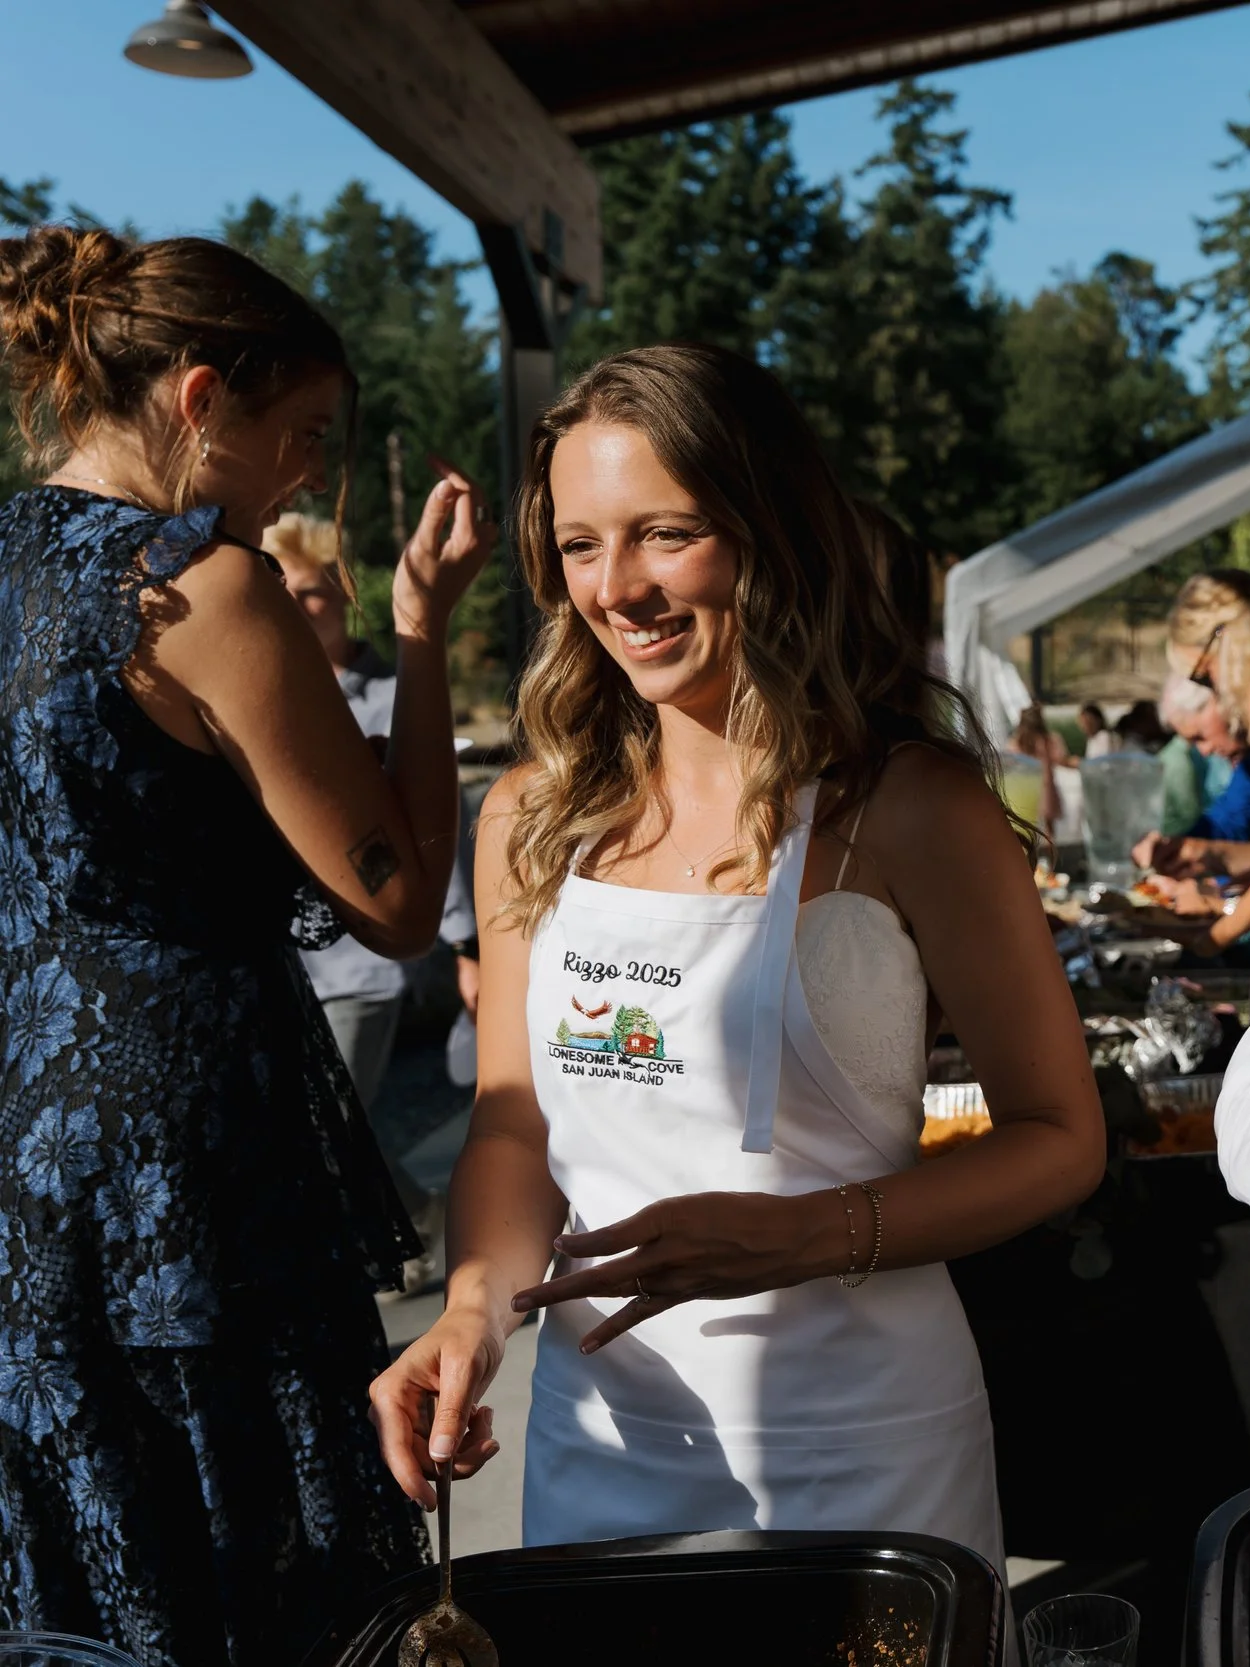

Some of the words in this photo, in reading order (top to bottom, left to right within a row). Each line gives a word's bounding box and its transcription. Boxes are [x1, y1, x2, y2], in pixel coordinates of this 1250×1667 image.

[563, 951, 621, 983] Rizzo
[626, 961, 682, 988] 2025
[548, 1045, 615, 1066] LONESOME
[647, 1061, 685, 1074] COVE
[562, 1063, 584, 1076] SAN
[588, 1067, 620, 1080] JUAN
[623, 1070, 664, 1086] ISLAND
